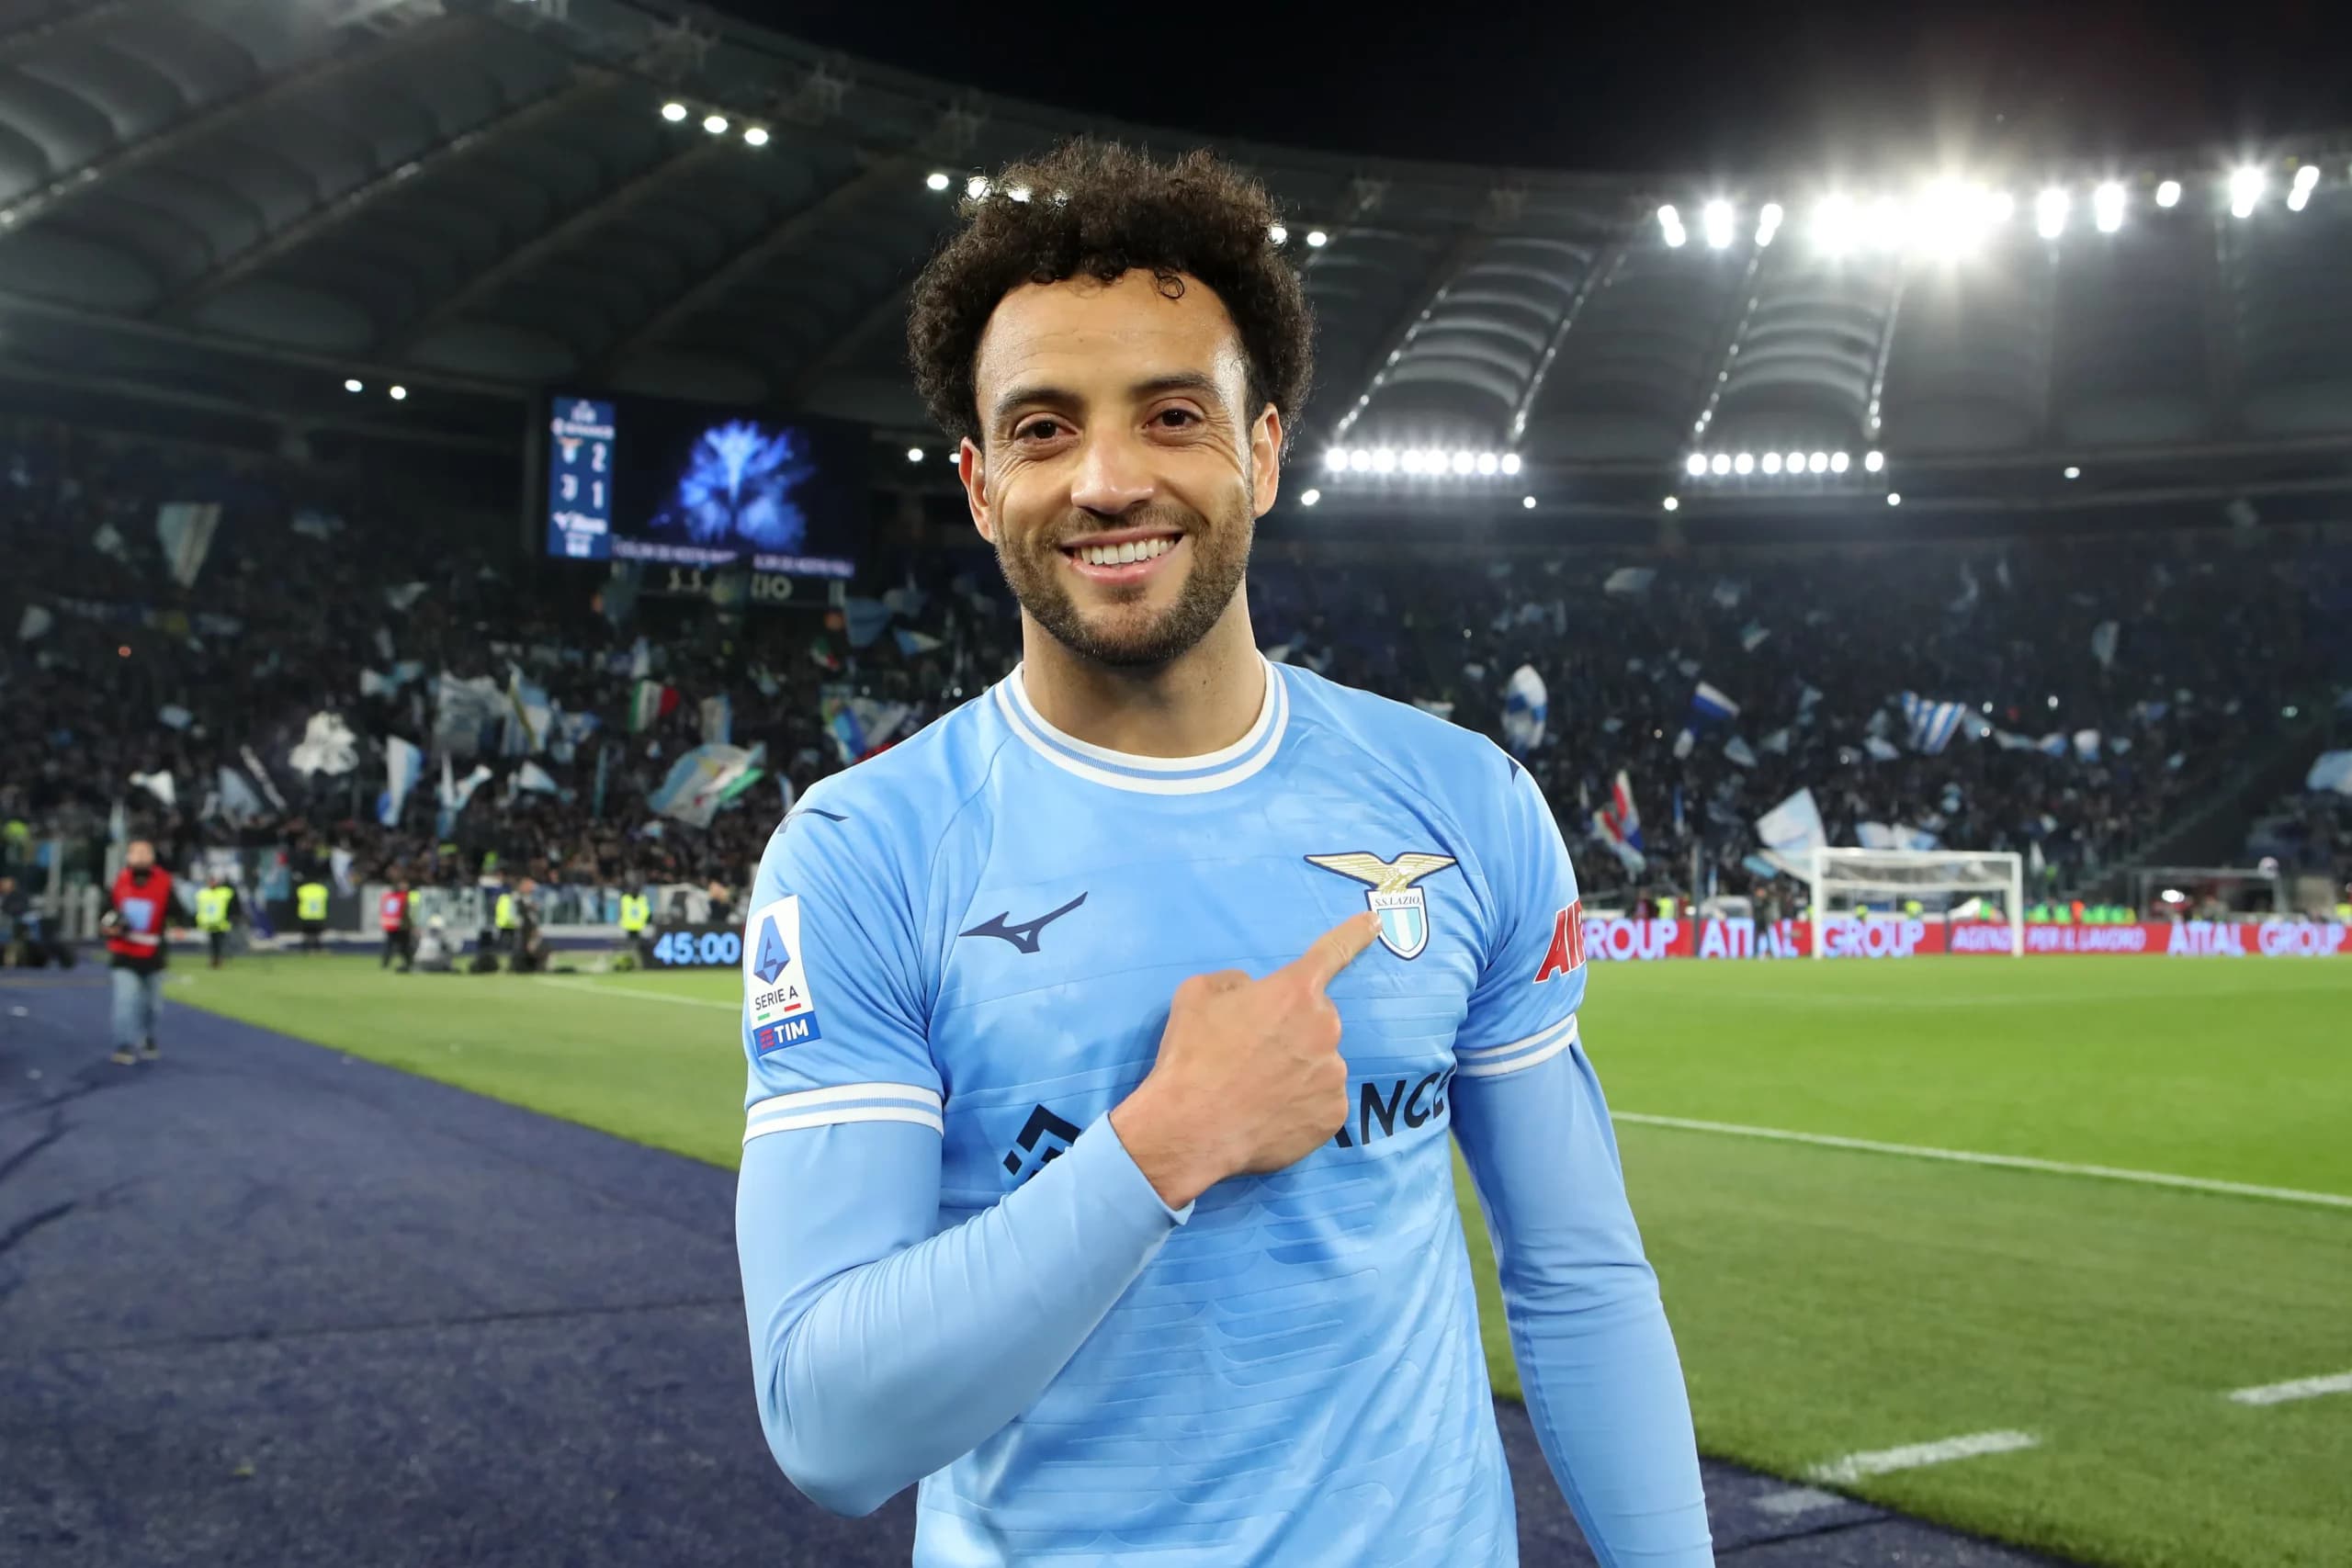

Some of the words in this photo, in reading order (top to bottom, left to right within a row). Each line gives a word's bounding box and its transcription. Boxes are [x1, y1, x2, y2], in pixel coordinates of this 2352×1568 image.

[591, 442, 606, 473] 2
[653, 931, 741, 964] 45:00
[1583, 919, 1679, 959] ROUP
[1823, 919, 1926, 957] GROUP
[2258, 919, 2346, 956] GROUP
[755, 988, 786, 1010] SERIE
[789, 985, 798, 999] A
[774, 1019, 808, 1043] TIM
